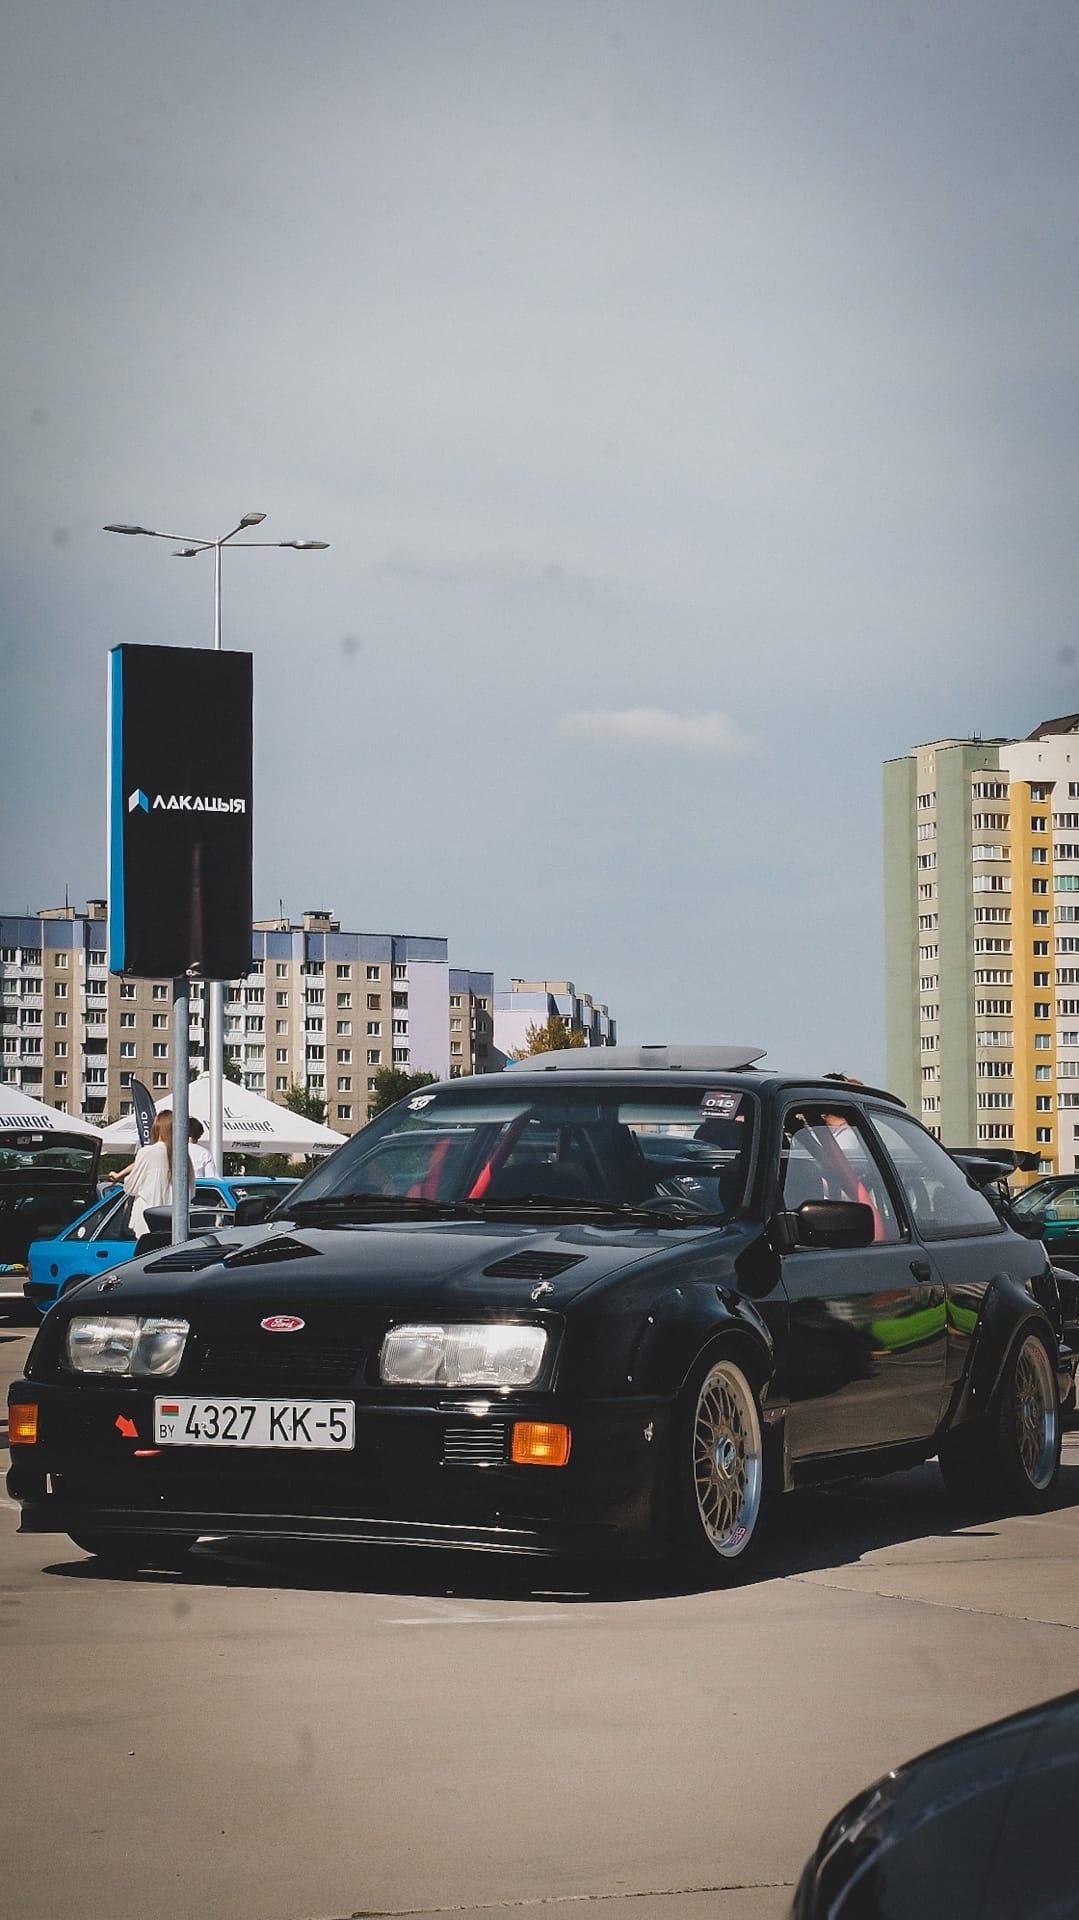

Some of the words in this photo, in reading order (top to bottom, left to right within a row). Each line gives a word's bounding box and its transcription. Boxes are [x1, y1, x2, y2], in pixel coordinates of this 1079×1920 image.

[152, 794, 246, 813] ЛАКАЦЫЯ
[705, 1098, 735, 1108] 015
[159, 1424, 176, 1439] BY
[185, 1404, 257, 1440] 4327
[269, 1406, 347, 1443] KK-5
